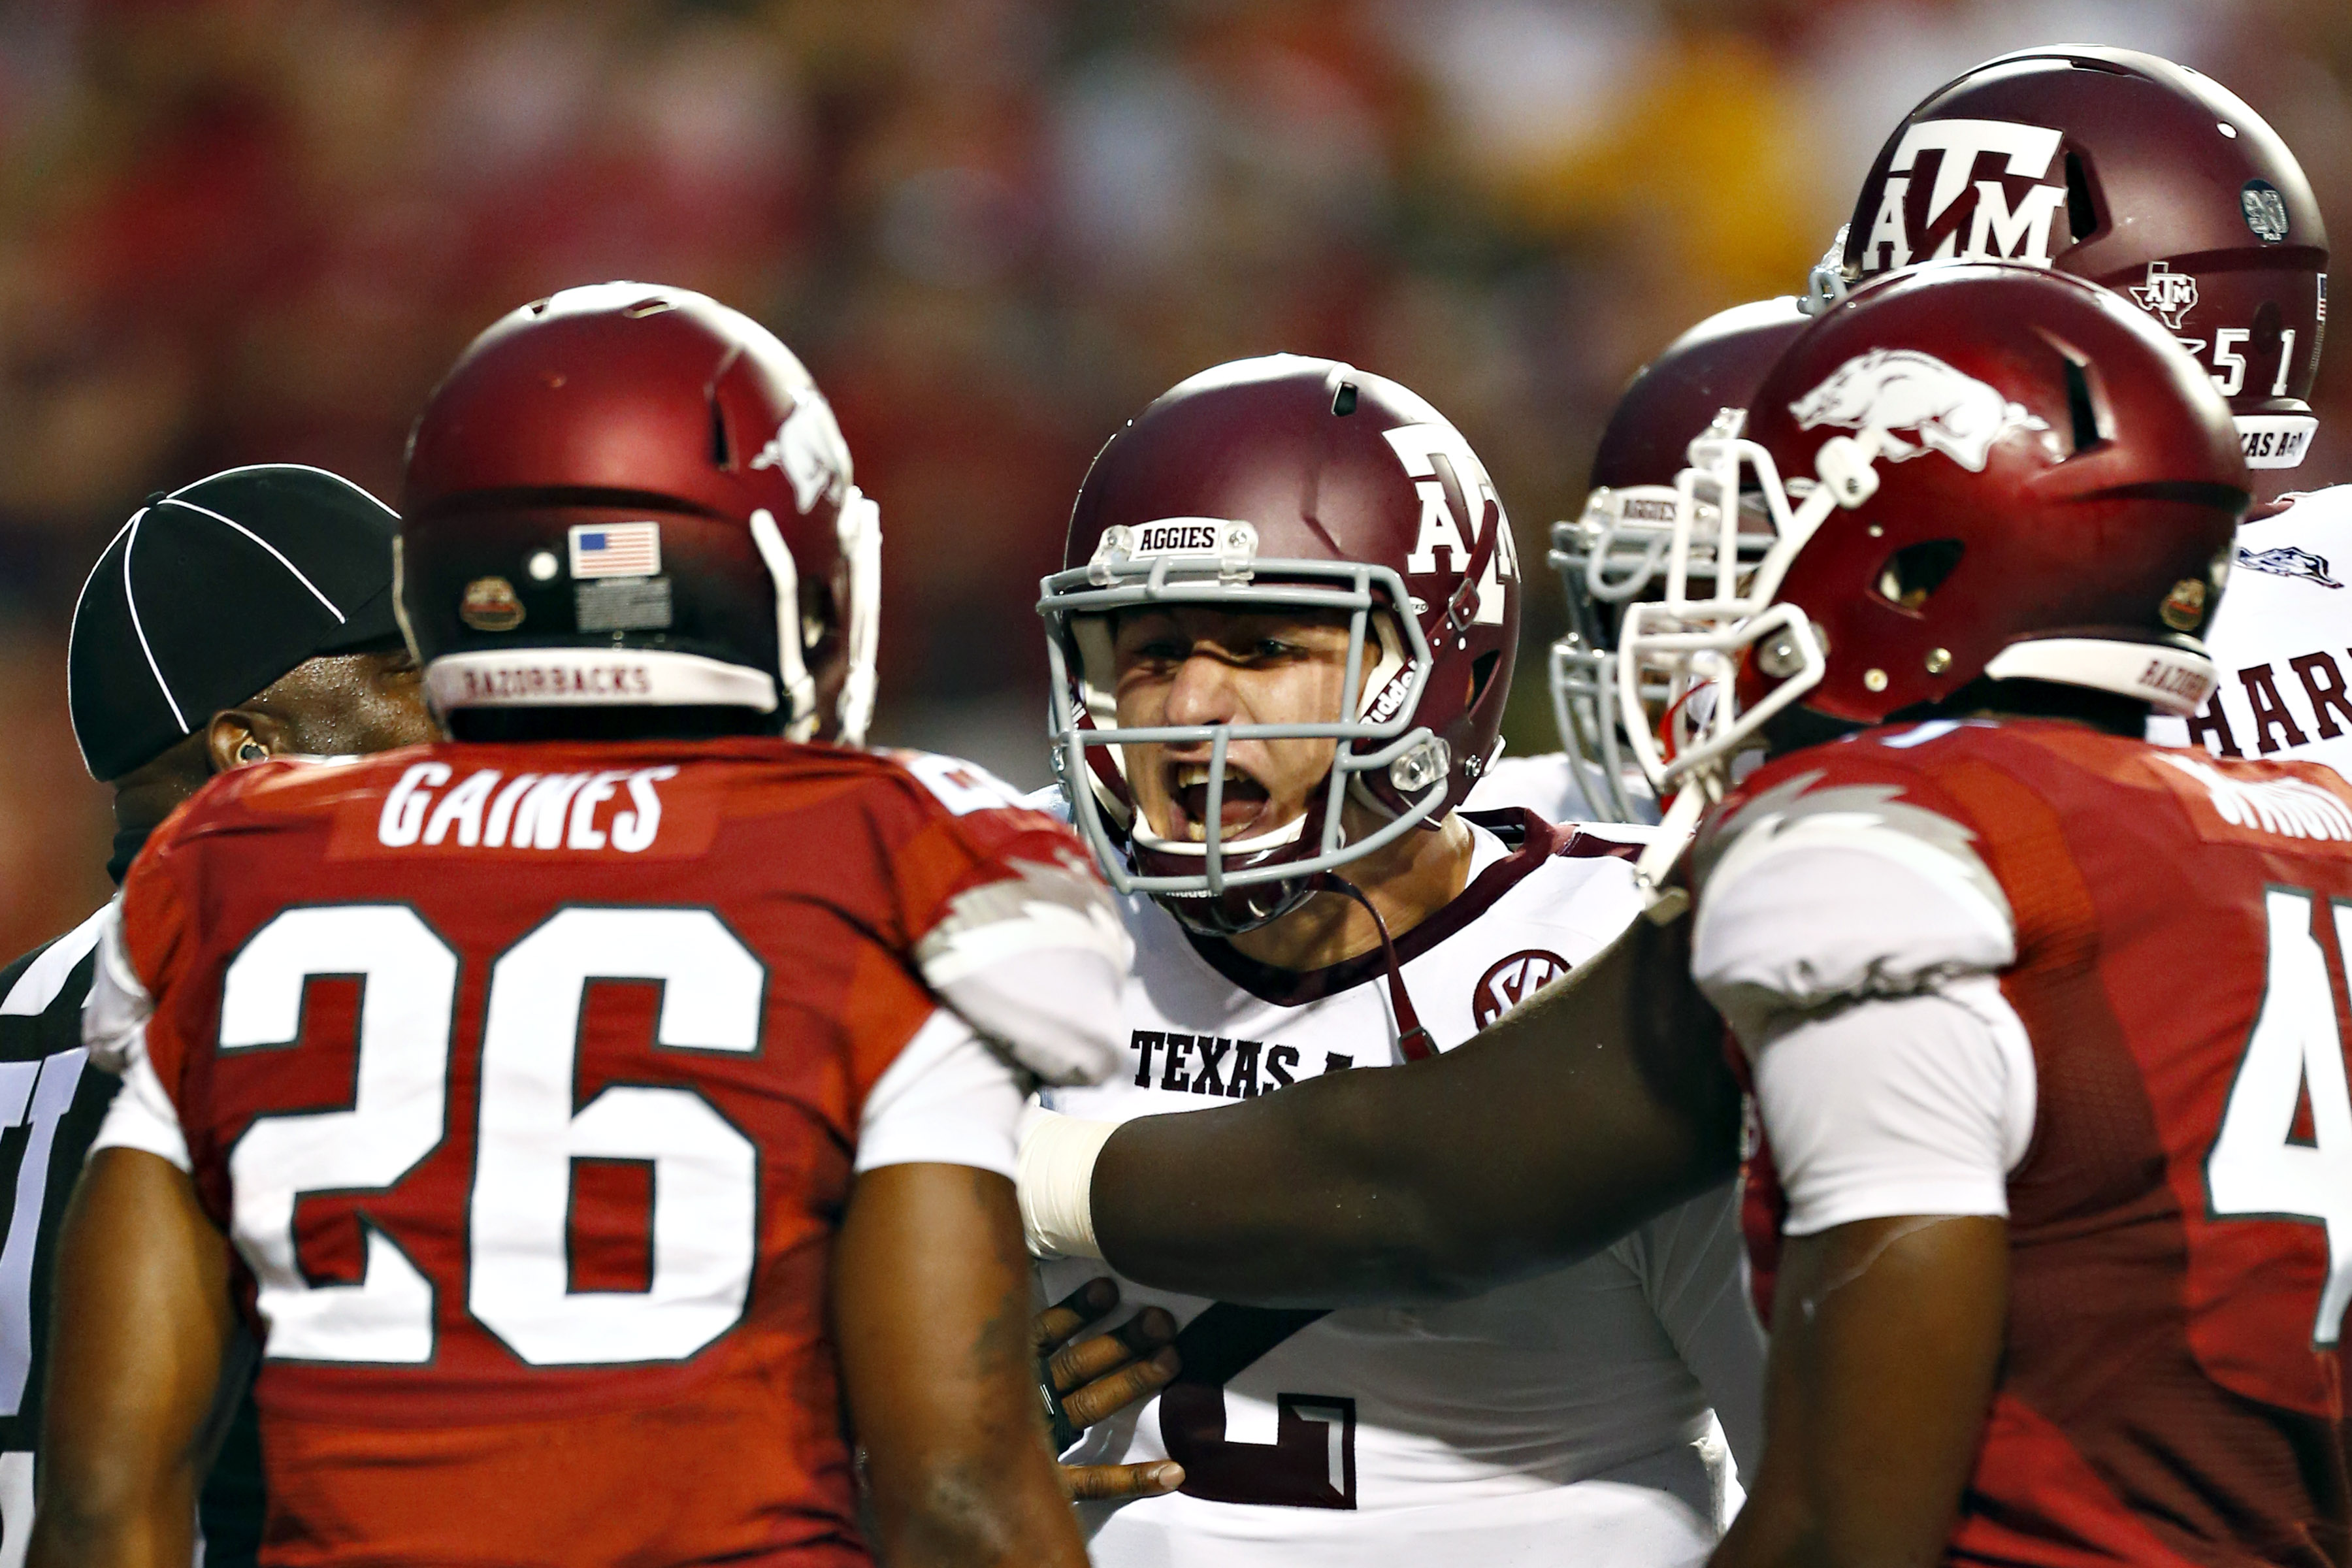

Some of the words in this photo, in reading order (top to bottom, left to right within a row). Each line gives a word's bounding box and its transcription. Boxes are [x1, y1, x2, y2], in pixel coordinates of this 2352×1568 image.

[1139, 527, 1216, 551] AGGIES
[2181, 647, 2352, 759] HAR
[378, 760, 679, 853] GAINES
[1130, 1028, 1300, 1100] TEXAS
[218, 900, 768, 1367] 26
